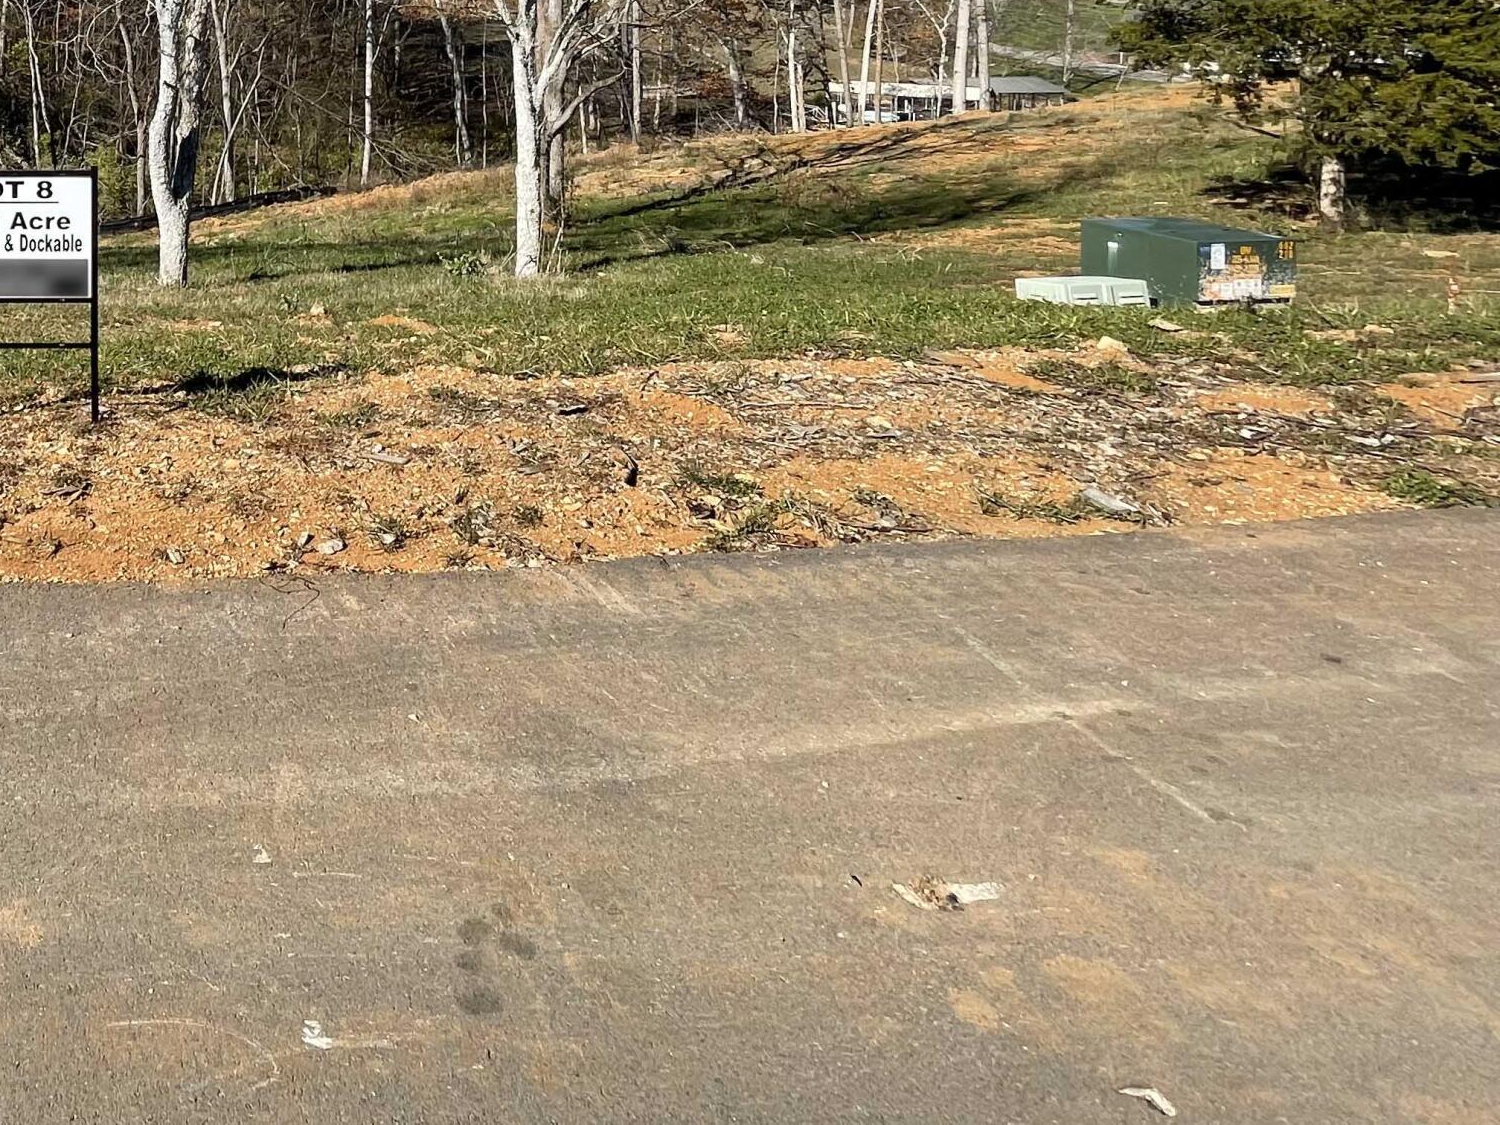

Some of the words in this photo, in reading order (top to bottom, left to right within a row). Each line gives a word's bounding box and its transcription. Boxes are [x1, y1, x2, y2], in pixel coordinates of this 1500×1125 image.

[36, 180, 54, 199] 8
[10, 211, 71, 230] Acre
[4, 234, 14, 252] &
[19, 233, 82, 252] Dockable
